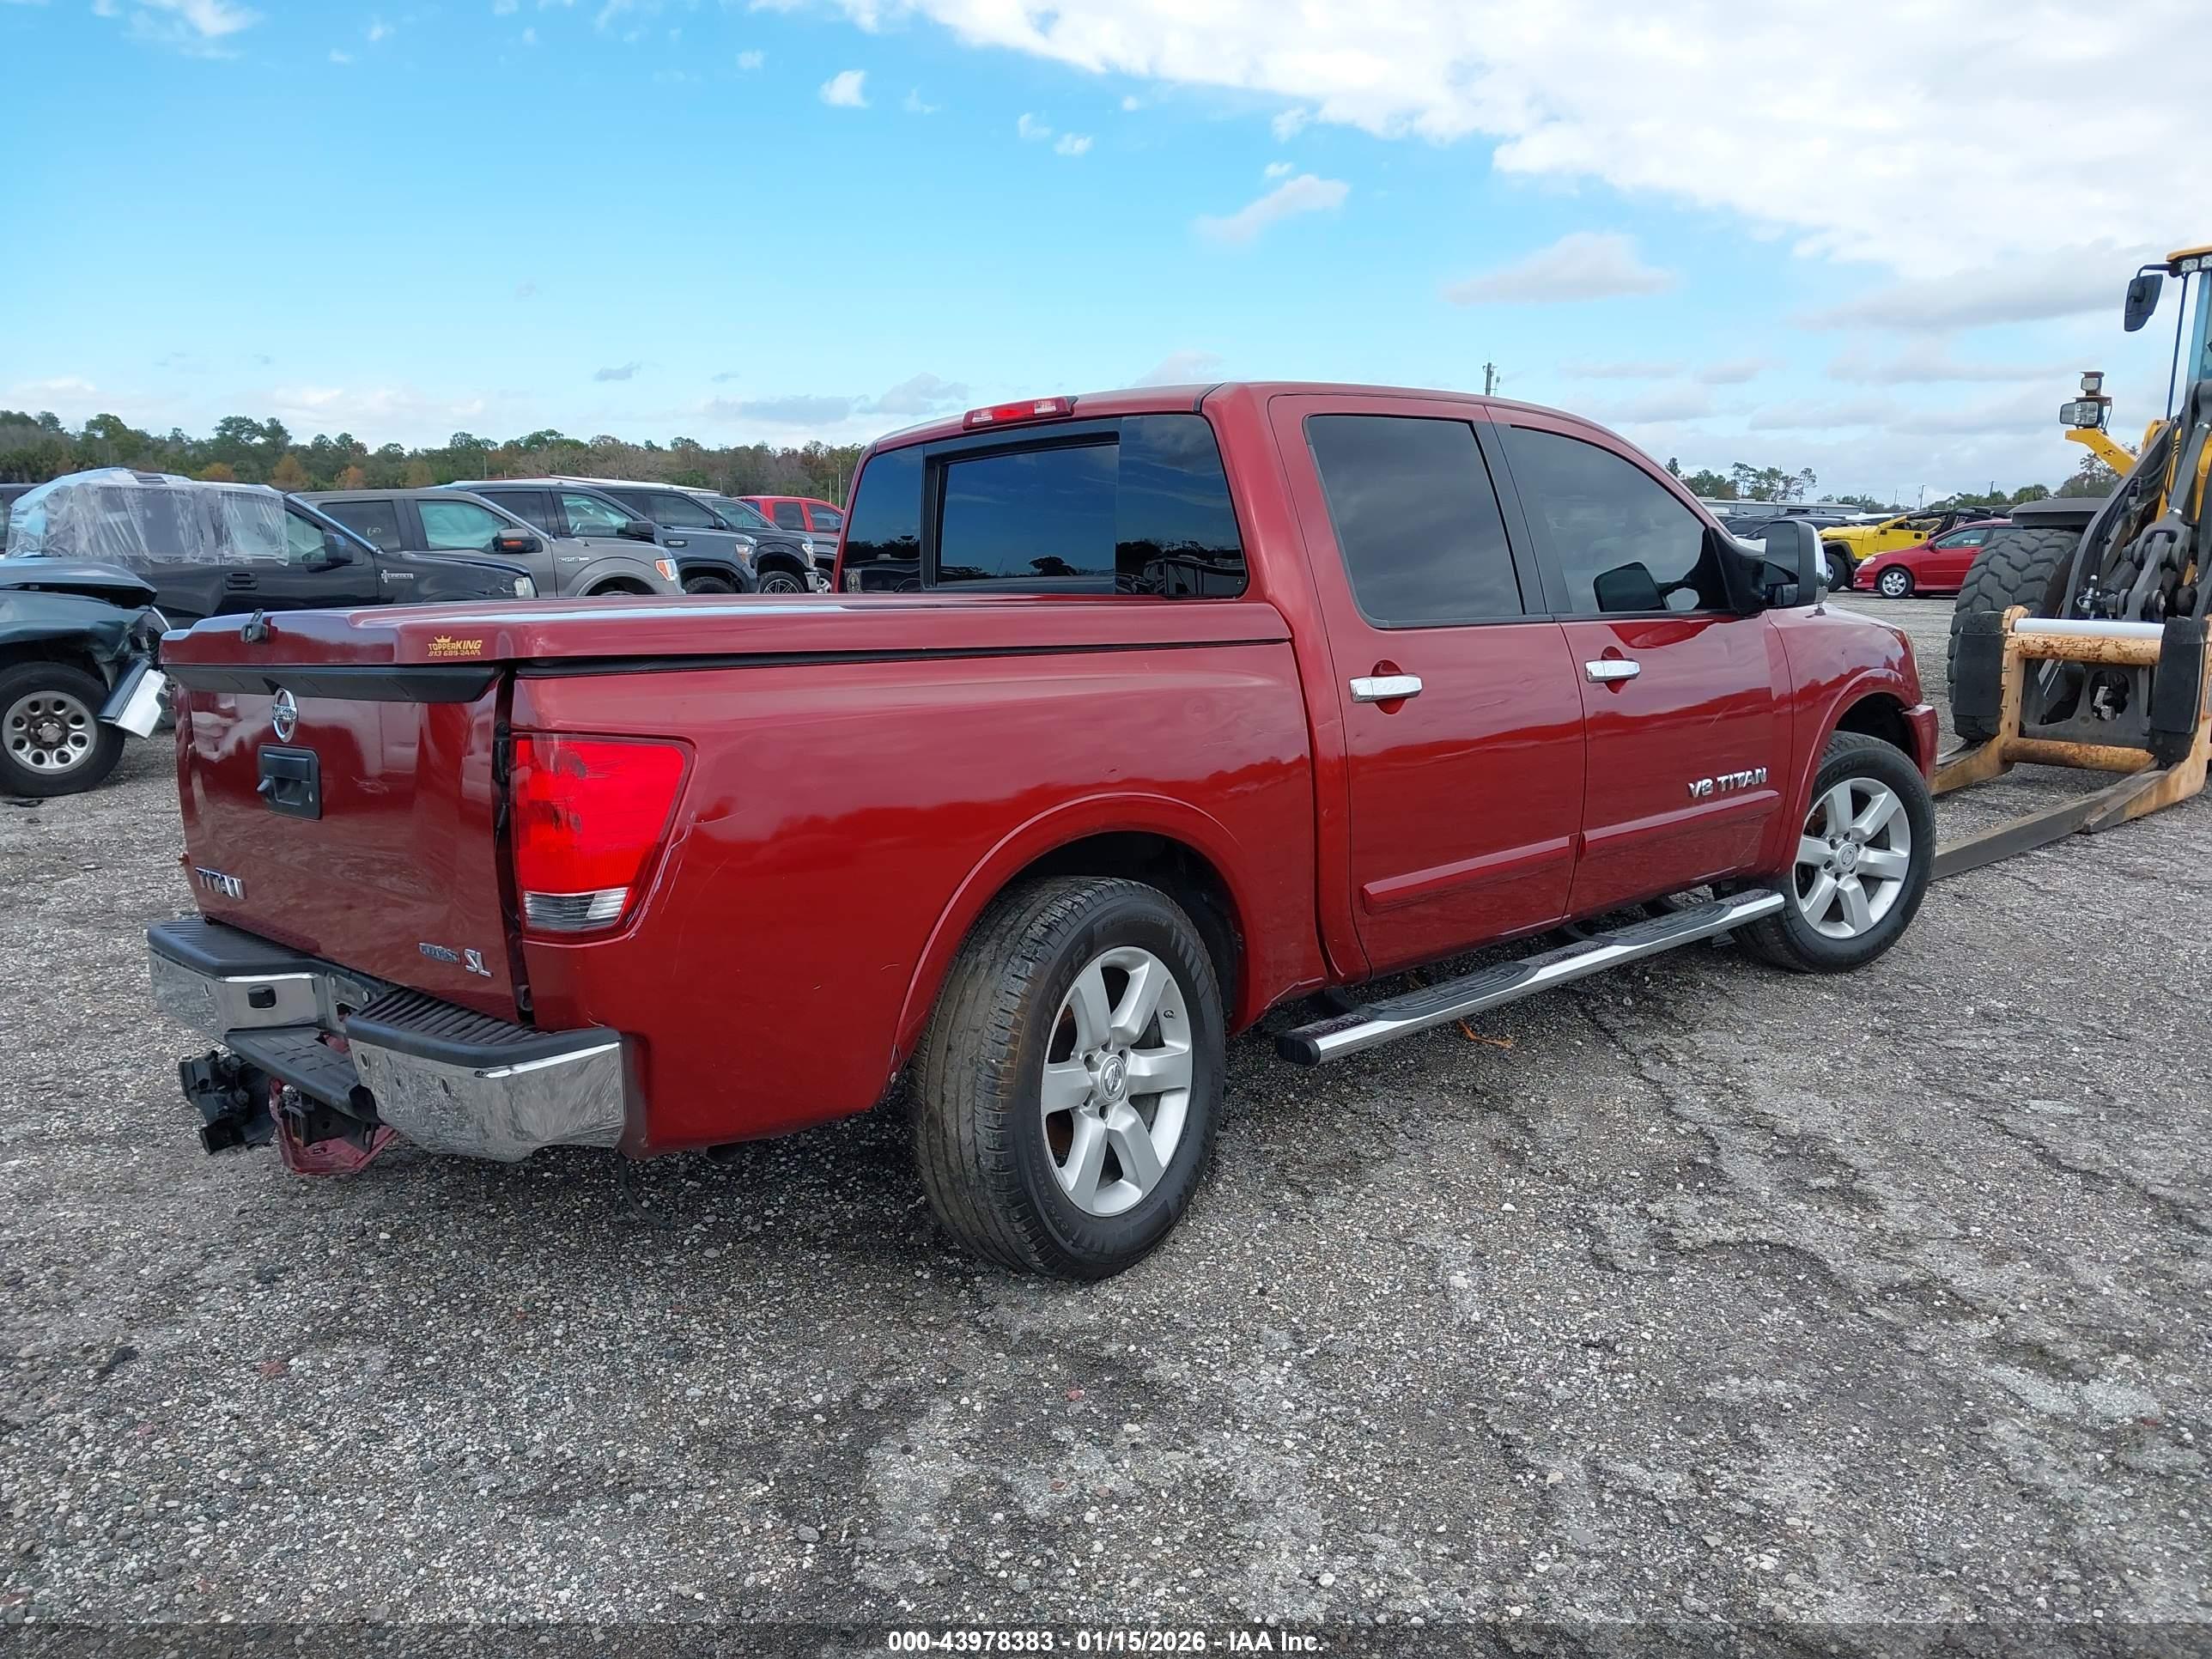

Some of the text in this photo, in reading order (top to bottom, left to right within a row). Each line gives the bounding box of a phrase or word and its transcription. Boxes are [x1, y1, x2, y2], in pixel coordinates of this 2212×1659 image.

[427, 640, 483, 651] TOPPERKING
[1688, 767, 1767, 799] V8 TITAN
[195, 866, 246, 900] TITAN
[465, 948, 492, 977] SL
